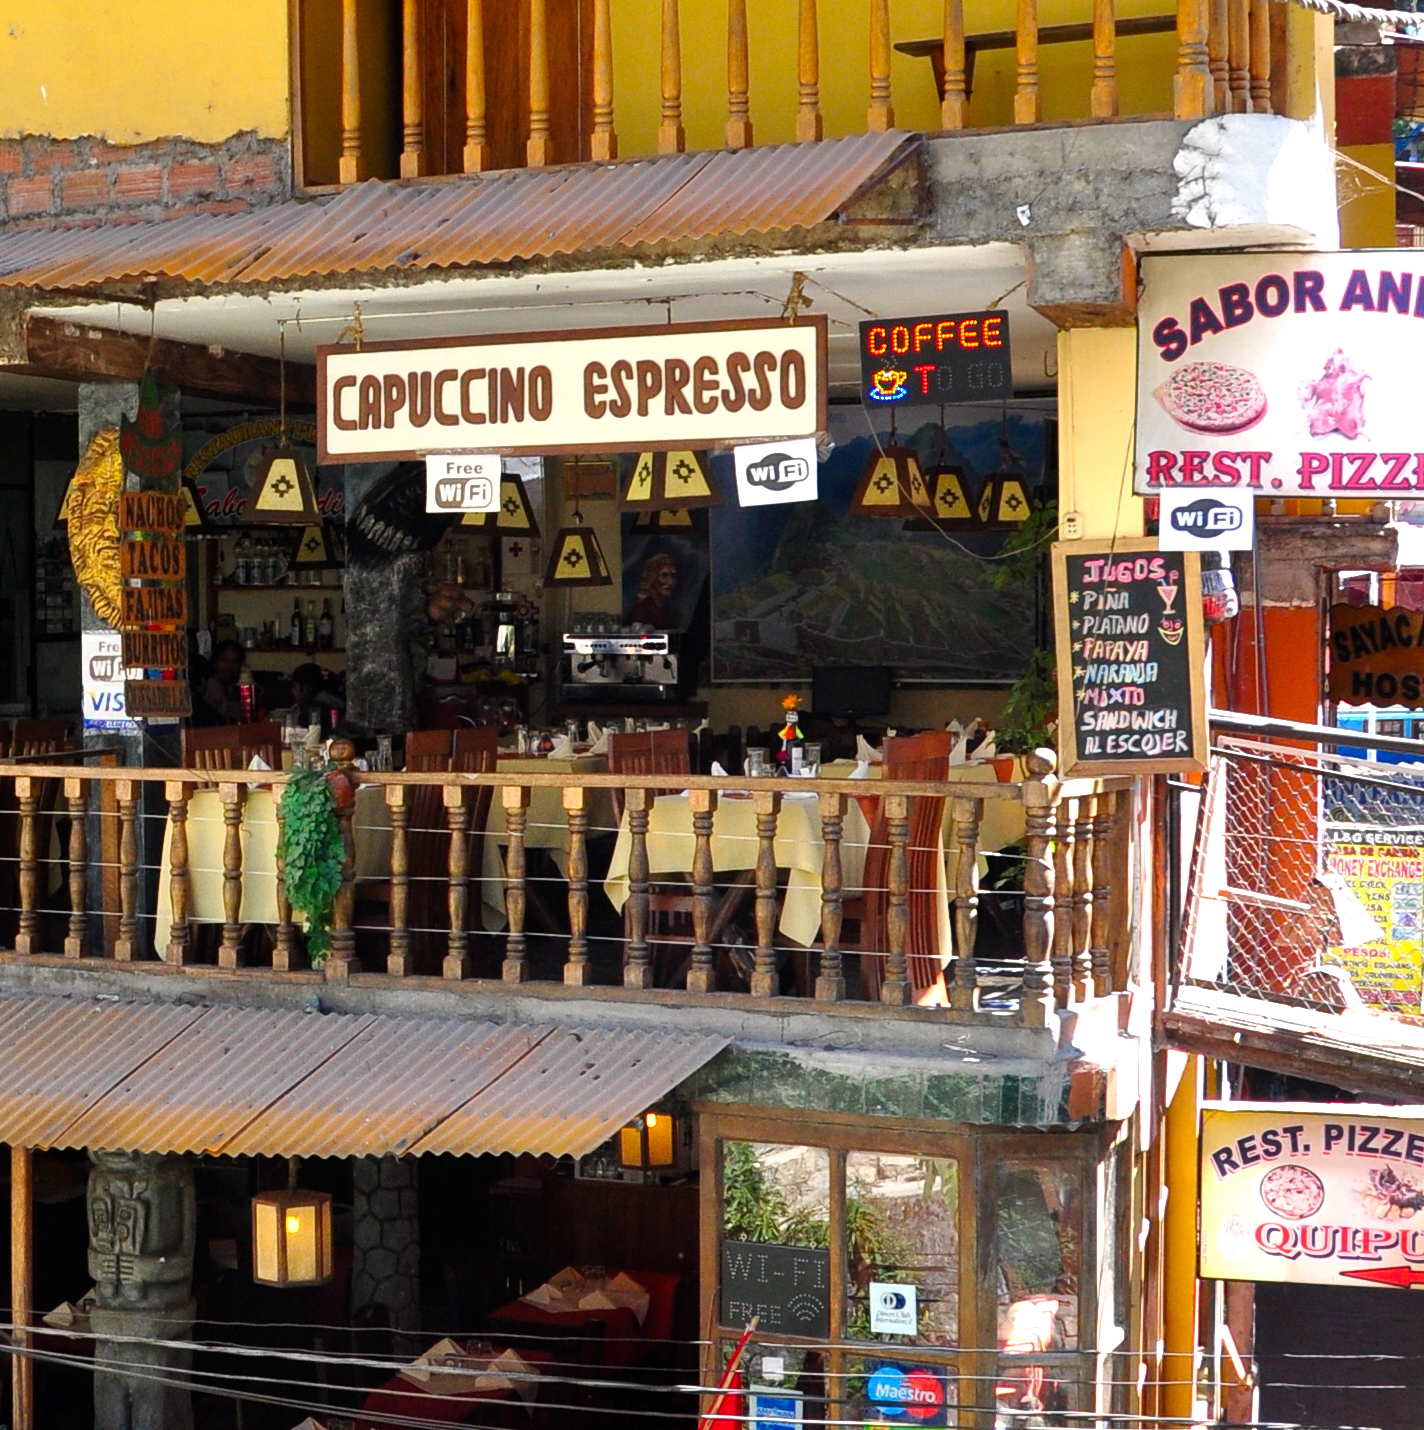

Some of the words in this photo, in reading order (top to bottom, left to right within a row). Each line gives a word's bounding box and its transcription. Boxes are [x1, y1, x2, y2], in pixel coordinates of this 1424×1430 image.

[1153, 271, 1327, 362] SABOR
[869, 318, 1002, 355] COFFEE
[333, 365, 553, 430] CAPUCCINO
[583, 349, 805, 419] ESPRESSO
[914, 363, 952, 394] TO
[446, 461, 483, 476] Free
[1146, 450, 1283, 489] REST.
[126, 496, 184, 530] NACHOS
[128, 542, 184, 576] TACOS
[1082, 558, 1166, 583] JUGOS
[126, 588, 184, 621] FAJITAS
[1083, 588, 1129, 610] PIÑA
[1082, 613, 1149, 635] PLATANO
[99, 642, 120, 652] Fre
[1083, 637, 1149, 661] PAPAYA
[1334, 614, 1412, 662] SAYAC
[1084, 662, 1158, 684] NARANJA
[1353, 672, 1424, 700] HOS
[91, 692, 124, 711] VIS
[1081, 709, 1176, 731] SANDWICH
[1085, 737, 1102, 754] AL
[1106, 731, 1188, 755] ESCOJER
[1367, 859, 1422, 879] EXCHANGE
[1211, 1125, 1310, 1181] REST.
[729, 1301, 781, 1324] FREE
[876, 1384, 936, 1403] Maestro
